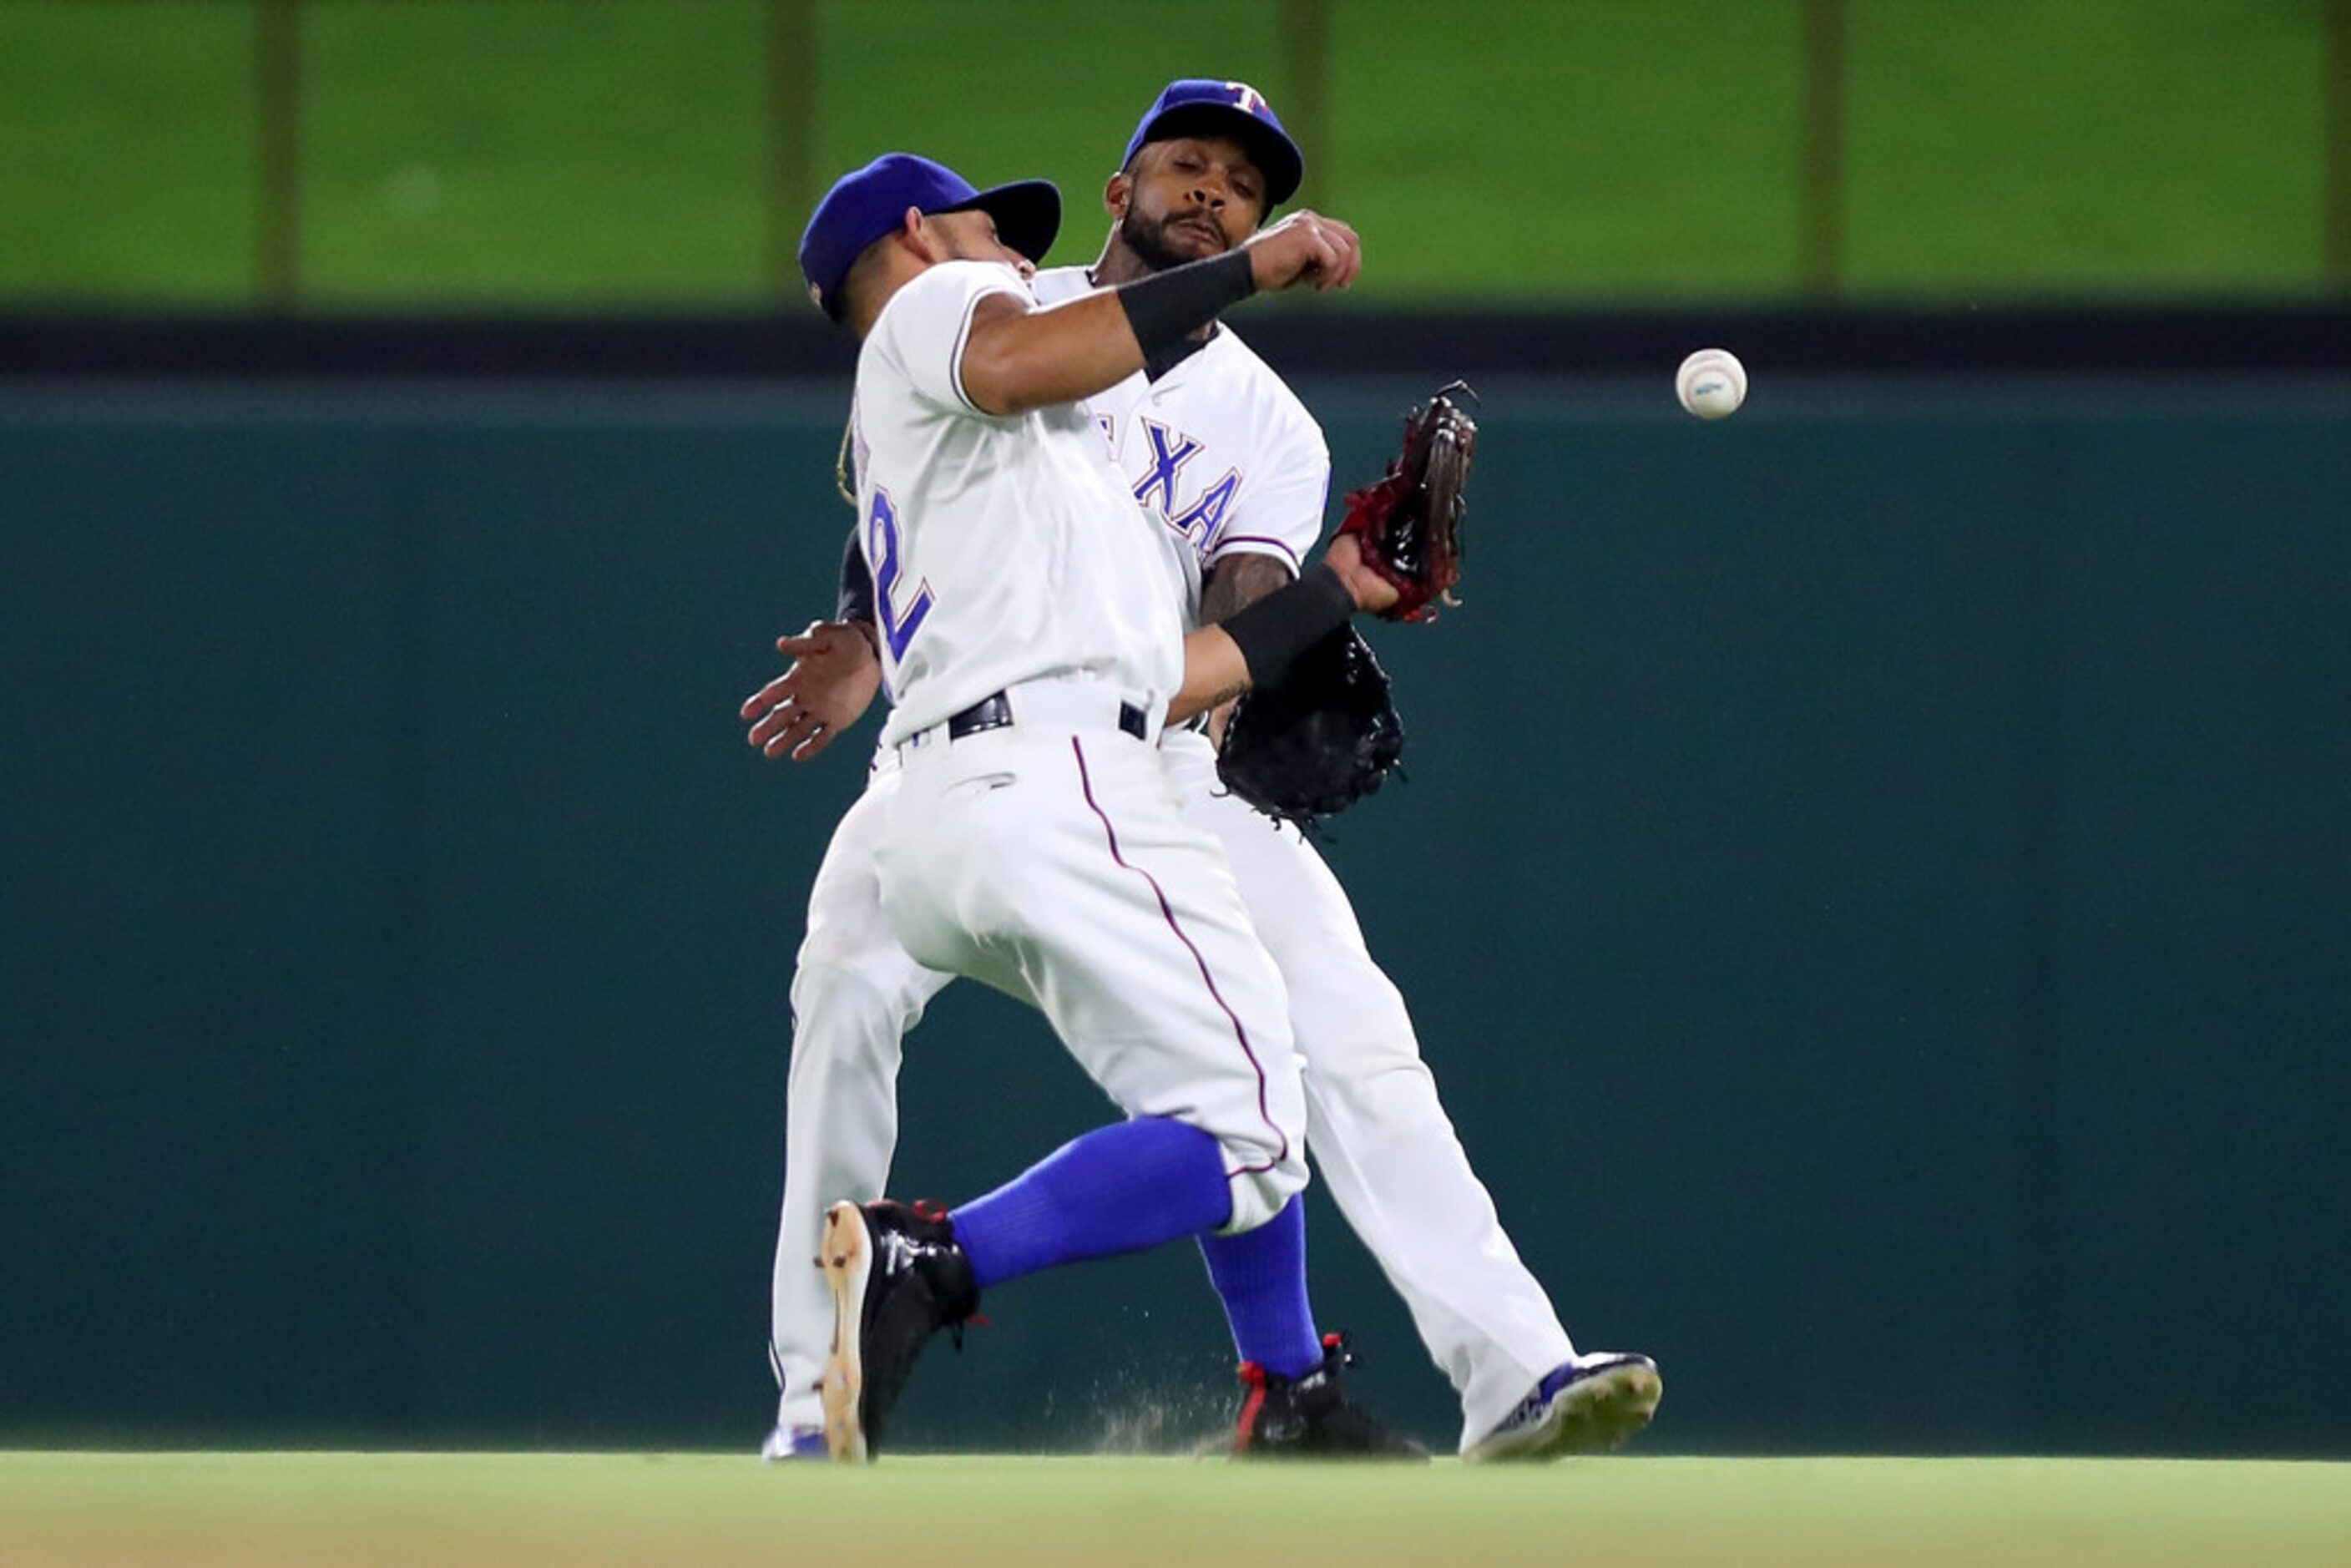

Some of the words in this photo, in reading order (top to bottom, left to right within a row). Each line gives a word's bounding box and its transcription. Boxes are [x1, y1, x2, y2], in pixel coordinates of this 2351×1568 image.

[1225, 81, 1267, 114] T
[1096, 414, 1242, 556] XA
[869, 485, 935, 664] 2
